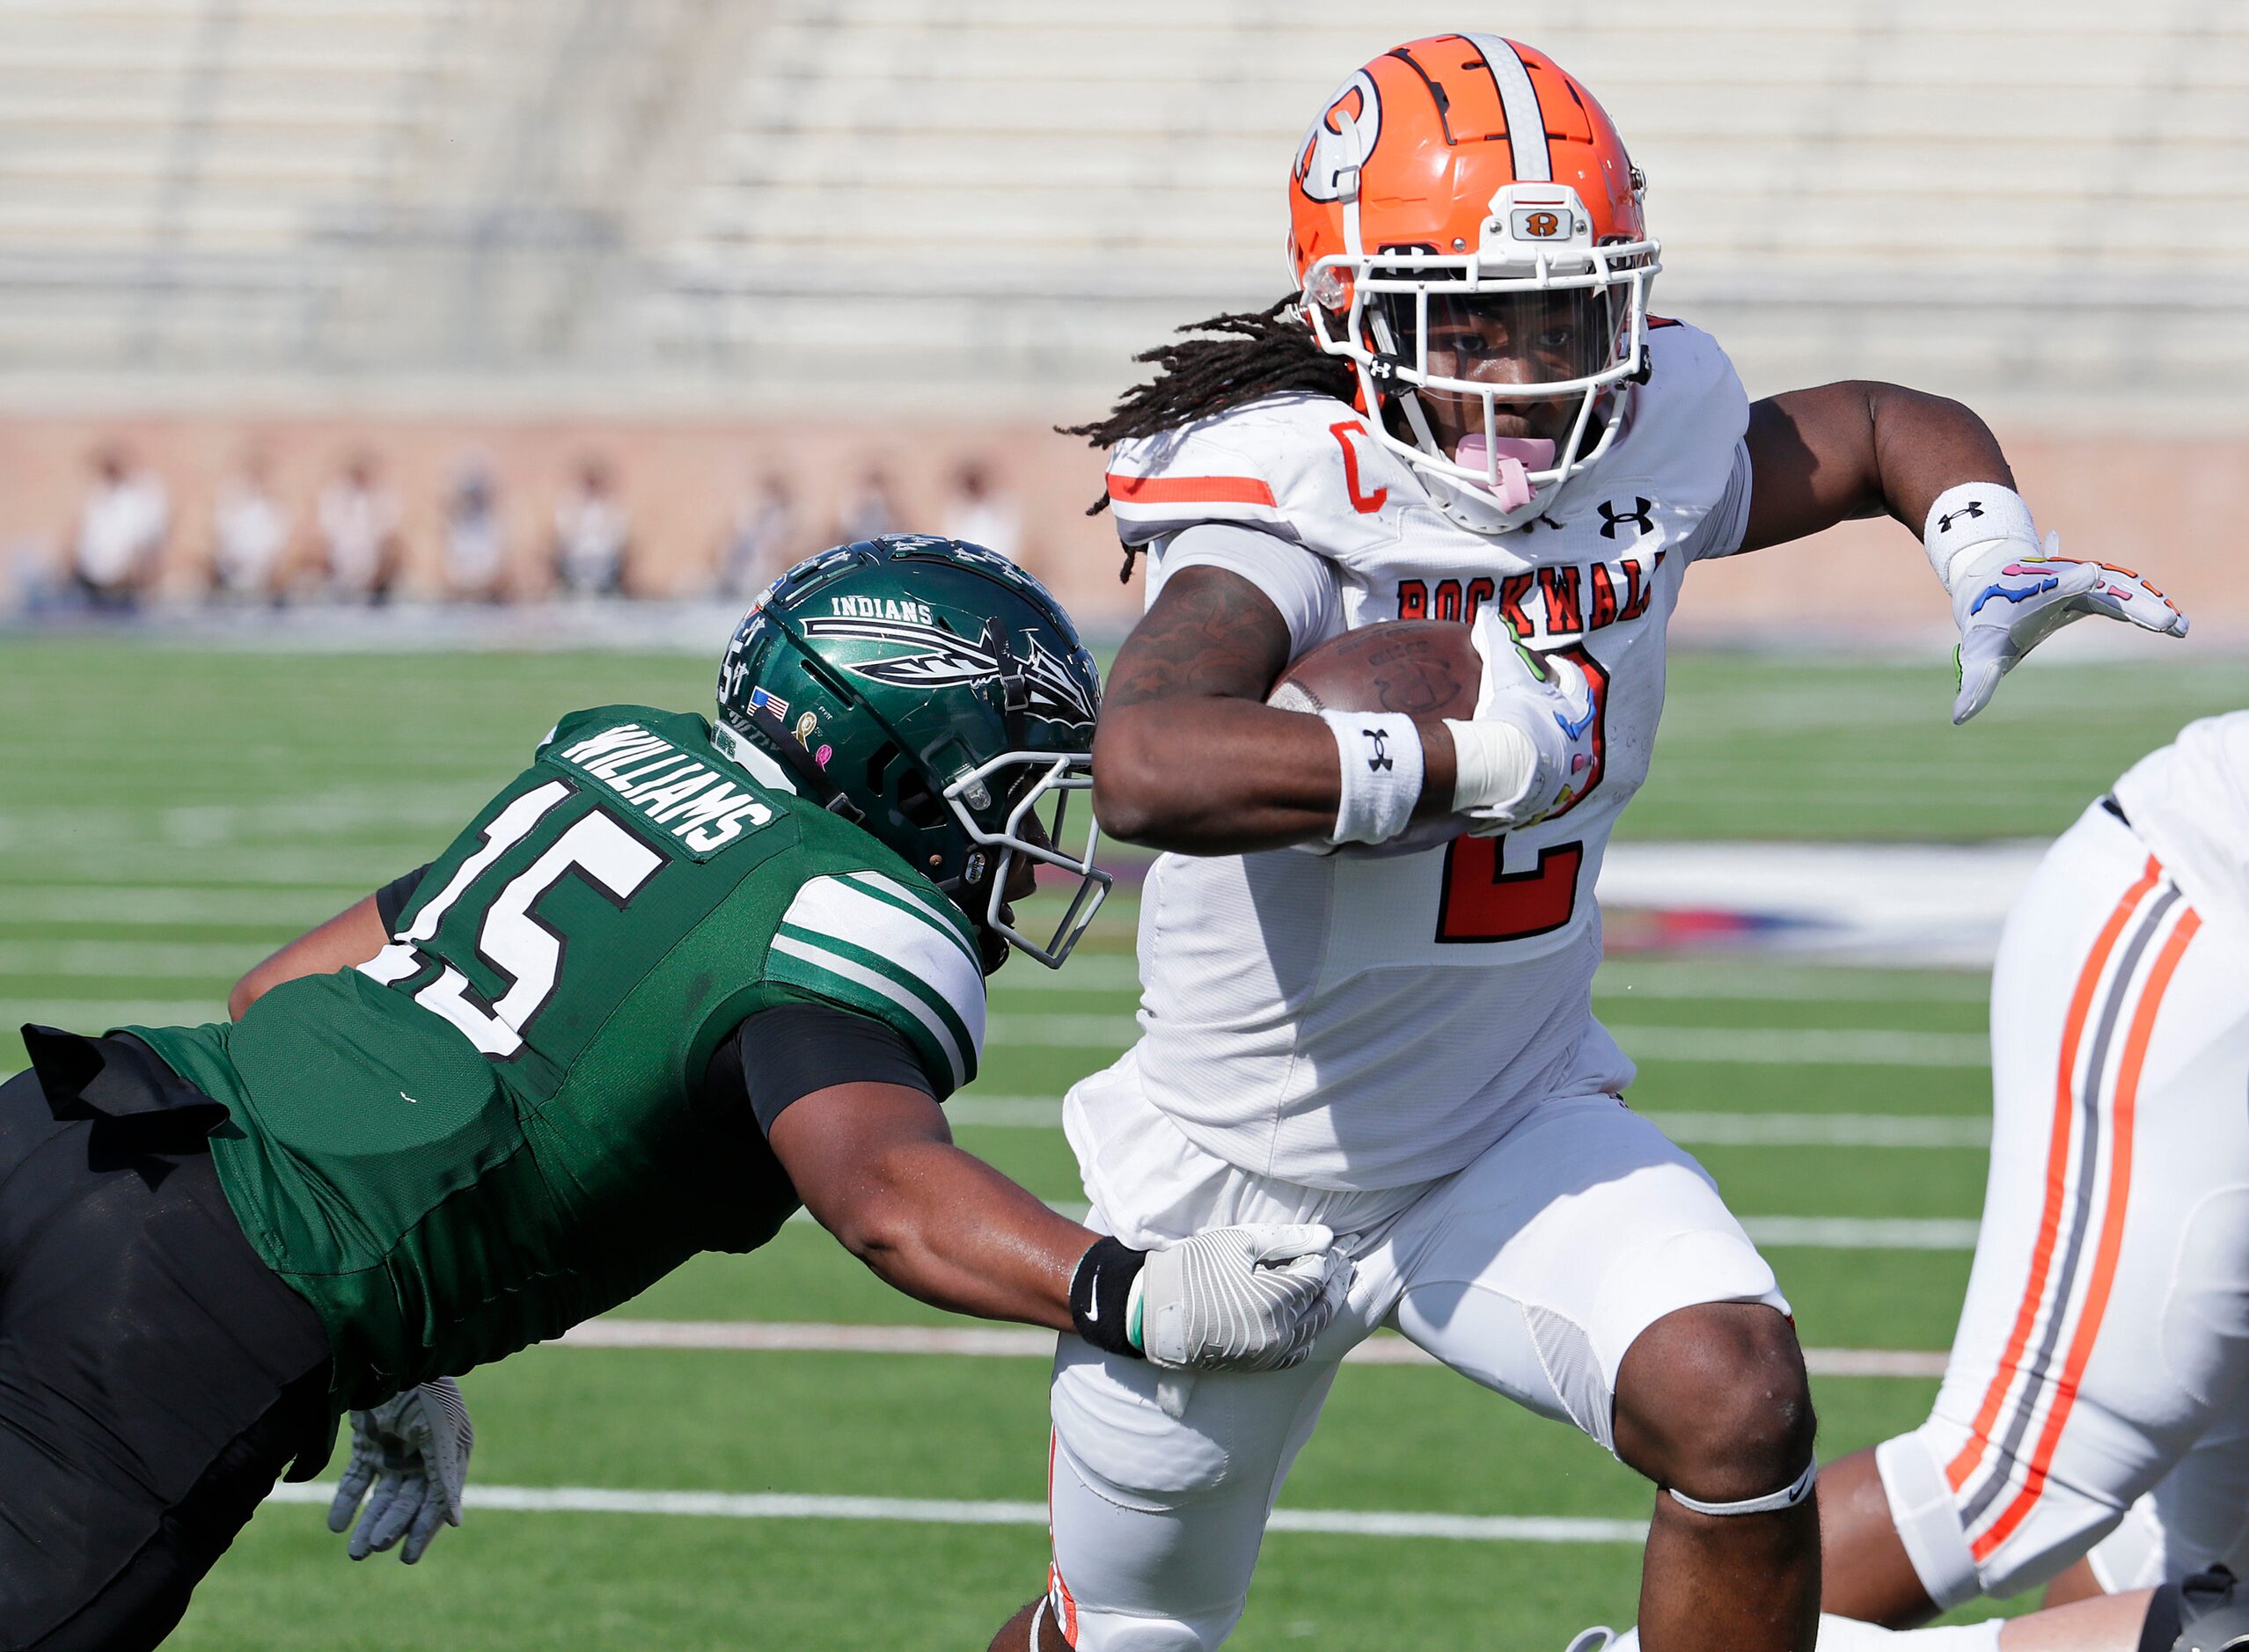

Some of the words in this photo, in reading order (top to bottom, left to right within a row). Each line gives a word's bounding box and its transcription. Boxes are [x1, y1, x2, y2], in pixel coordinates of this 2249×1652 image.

[1525, 212, 1559, 237] R
[1329, 420, 1388, 514] C
[831, 596, 933, 625] INDIANS
[560, 723, 773, 852] WILLIAMS
[1433, 641, 1609, 944] 2
[355, 776, 674, 1063] 15
